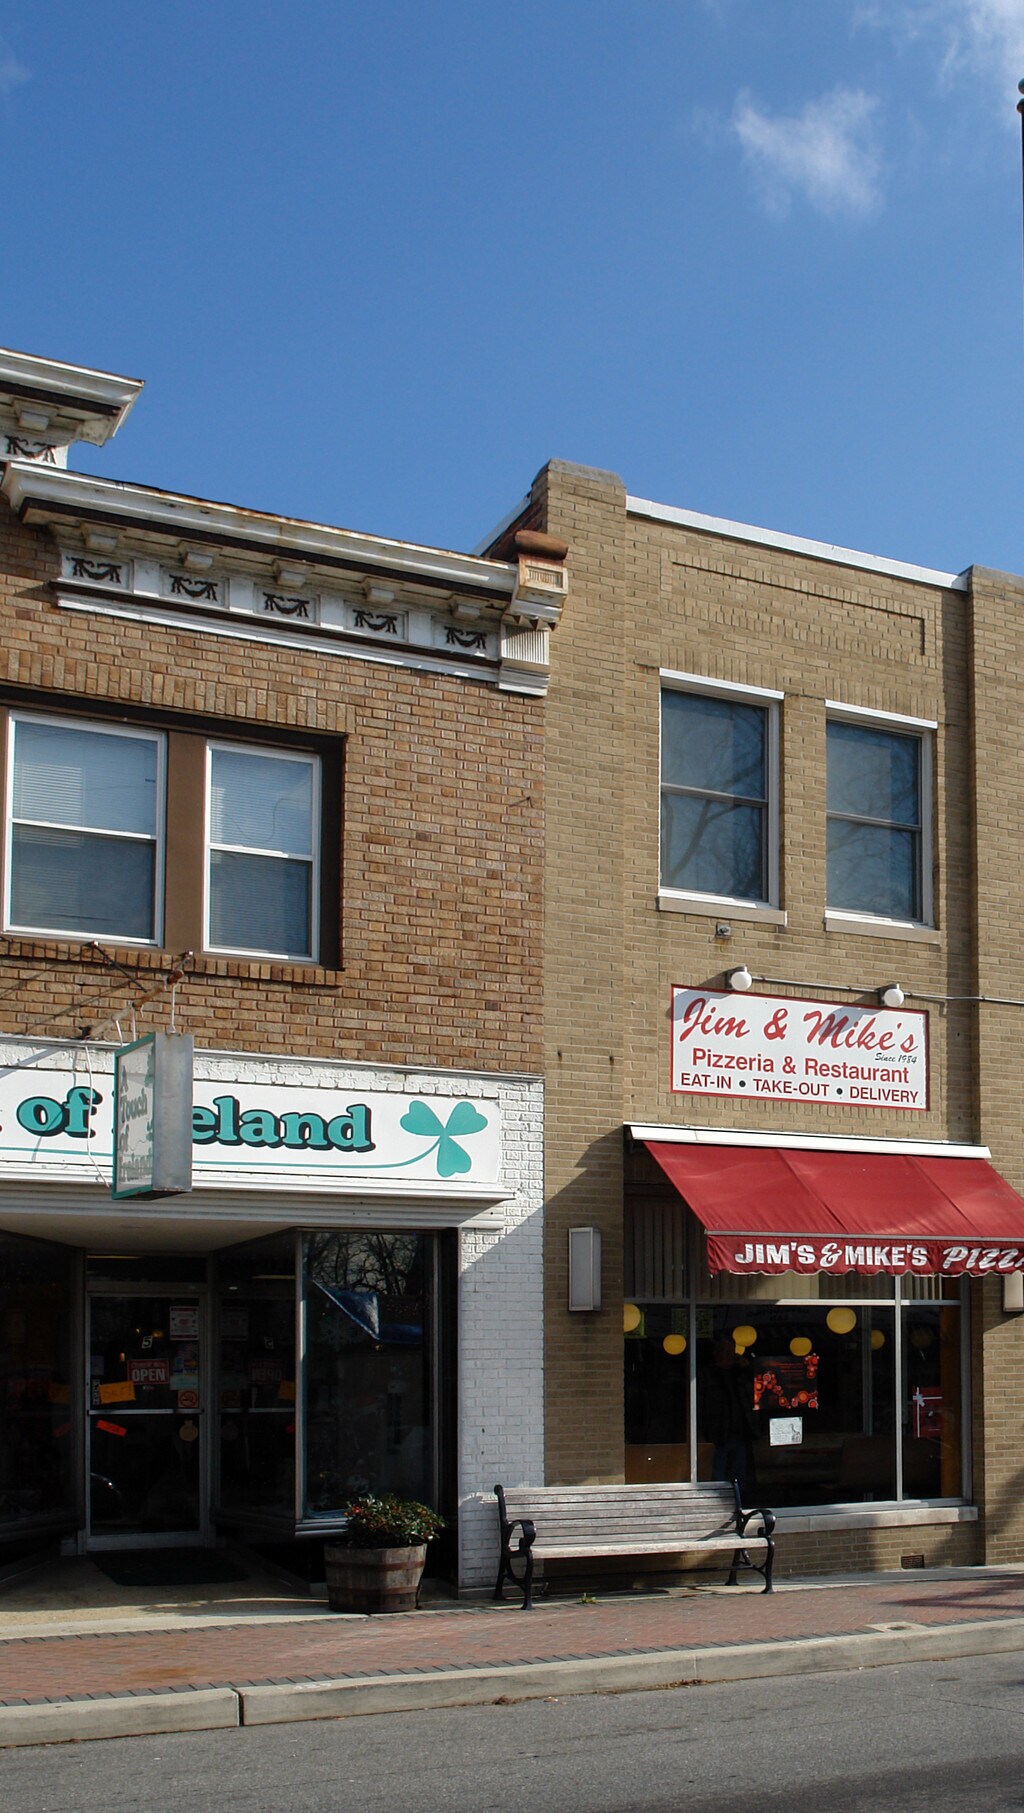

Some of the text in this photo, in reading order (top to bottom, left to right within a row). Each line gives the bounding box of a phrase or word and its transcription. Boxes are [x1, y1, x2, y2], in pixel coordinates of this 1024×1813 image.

[678, 997, 918, 1053] Jim & Mike's
[692, 1047, 909, 1084] Pizzeria & Restaurant
[875, 1052, 917, 1064] Since 1984
[681, 1072, 919, 1104] EAT-IN TAKE-OUT DELIVERY
[16, 1086, 103, 1138] of
[120, 1087, 148, 1124] Touch
[734, 1242, 816, 1266] JIM'S
[819, 1242, 842, 1268] &
[845, 1244, 927, 1266] MIKE'S
[132, 1368, 166, 1382] OPEN
